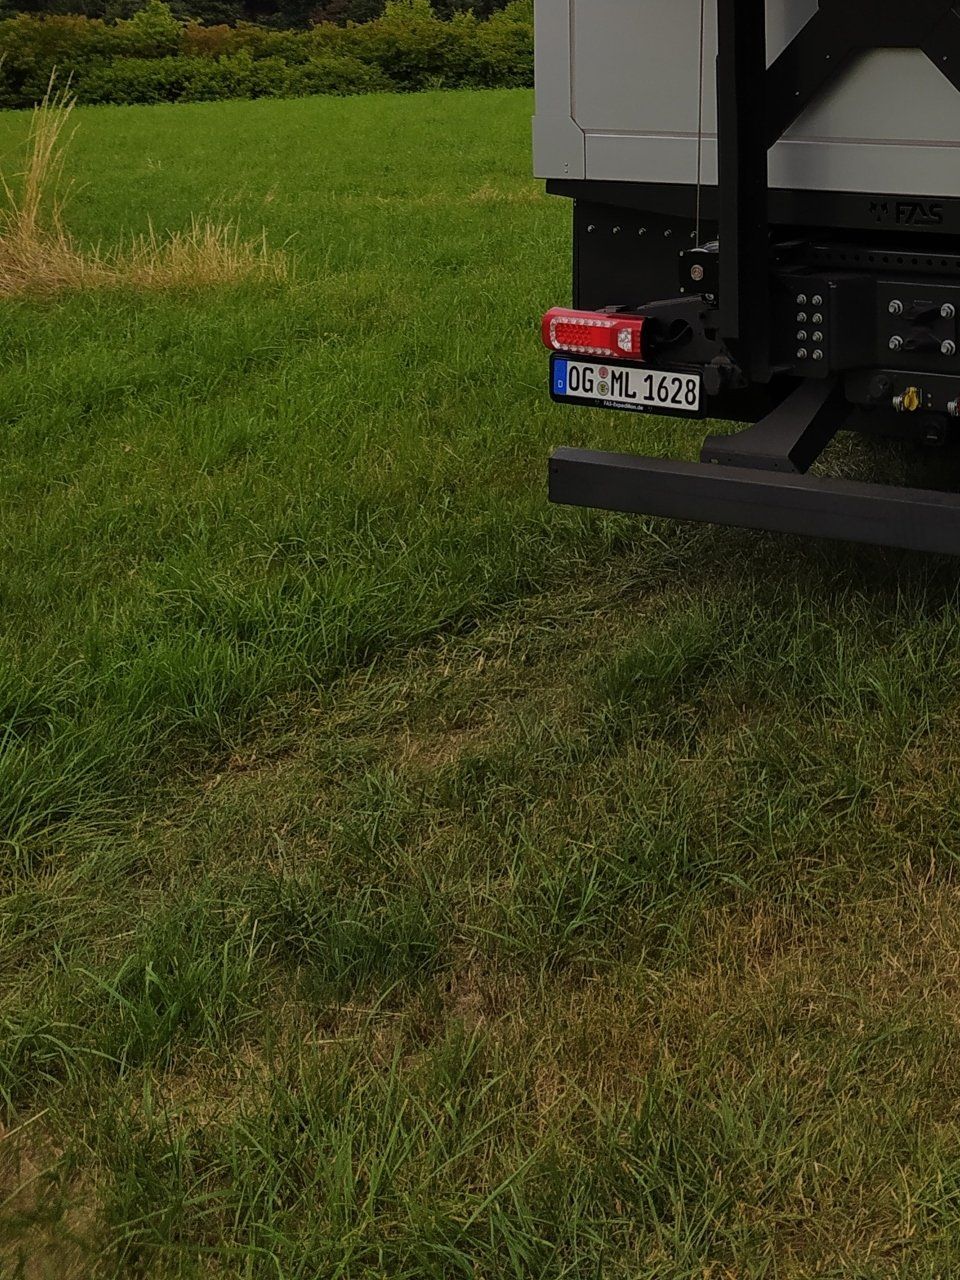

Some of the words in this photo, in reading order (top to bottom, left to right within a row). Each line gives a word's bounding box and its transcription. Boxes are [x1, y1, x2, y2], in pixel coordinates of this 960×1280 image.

[895, 201, 944, 225] FAS
[557, 380, 563, 389] D
[568, 365, 594, 393] OG
[610, 370, 637, 399] ML
[643, 374, 697, 406] 1628
